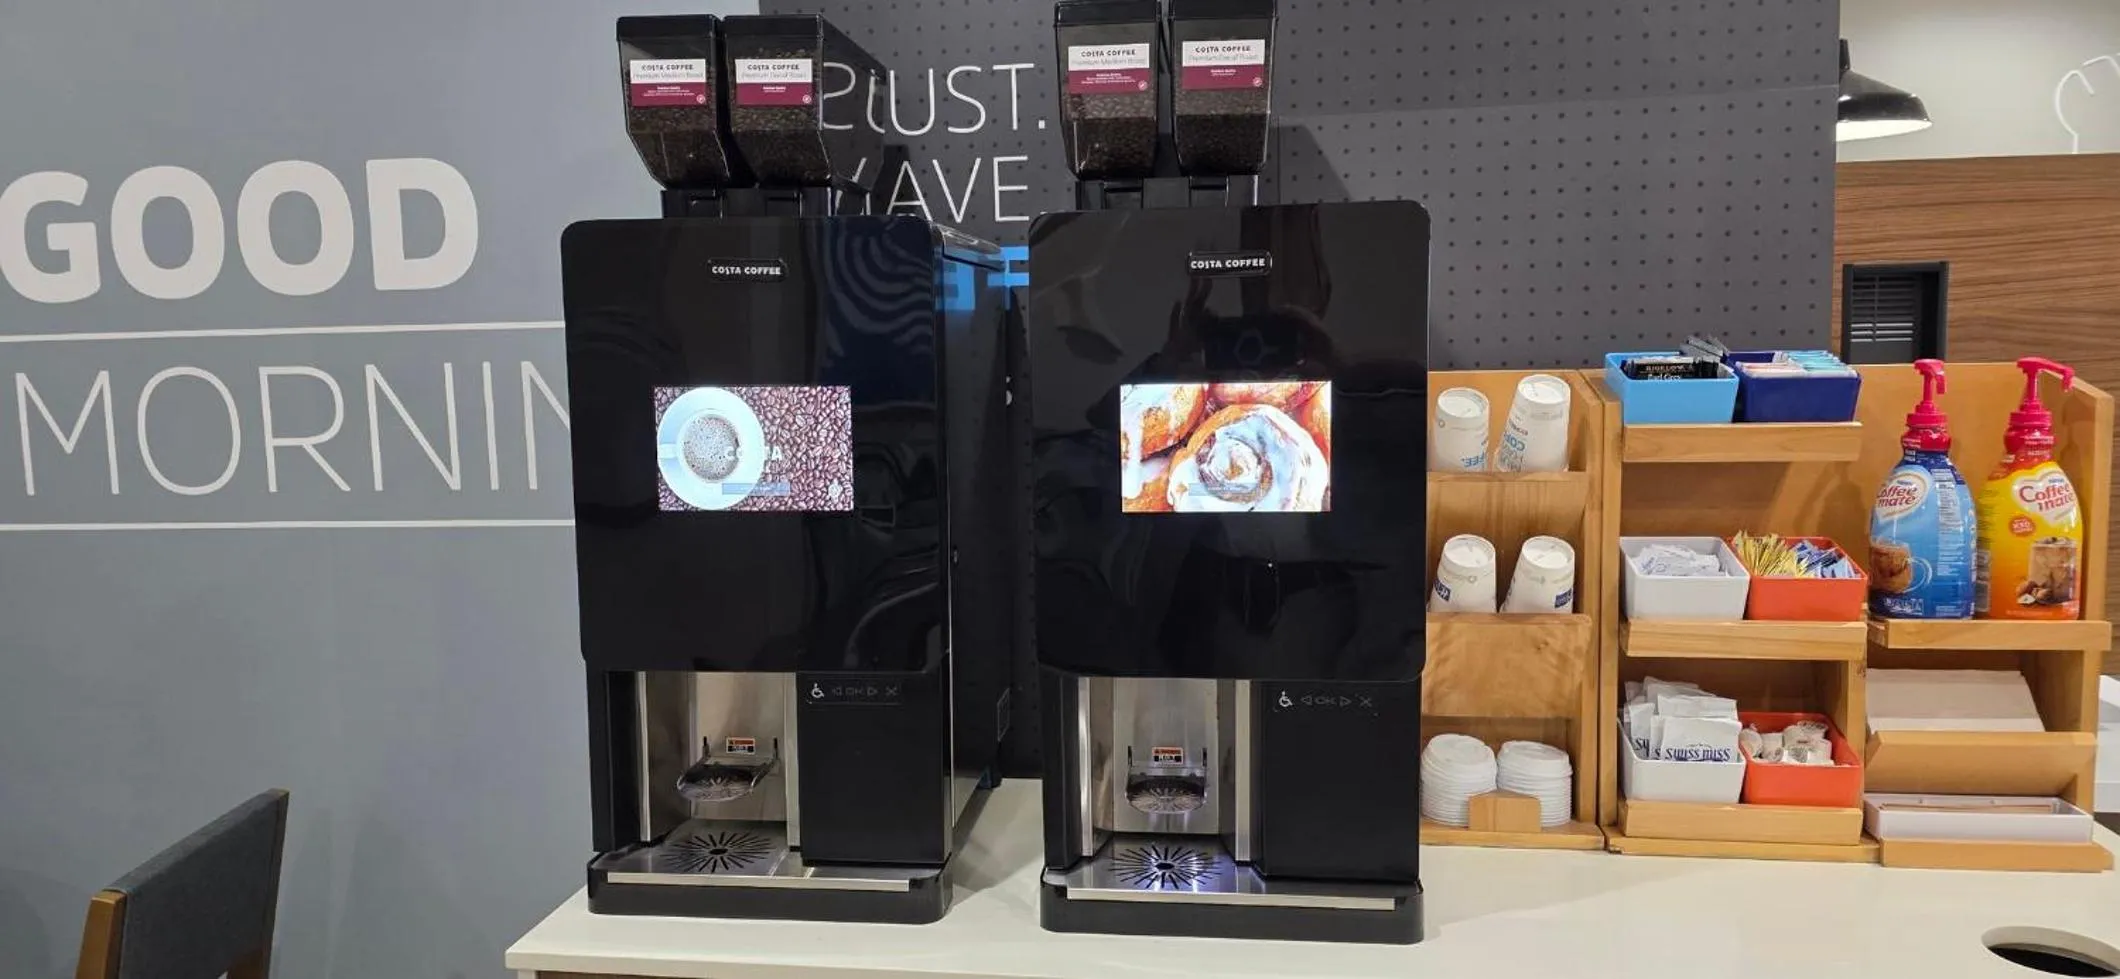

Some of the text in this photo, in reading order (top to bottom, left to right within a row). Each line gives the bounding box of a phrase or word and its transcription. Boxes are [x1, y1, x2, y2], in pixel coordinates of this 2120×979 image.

[822, 59, 1046, 136] UST.
[0, 158, 478, 302] GOOD
[712, 266, 781, 275] COSTA COFFEE
[1191, 258, 1266, 269] COSTA COFFEE
[2019, 484, 2071, 503] Coffee
